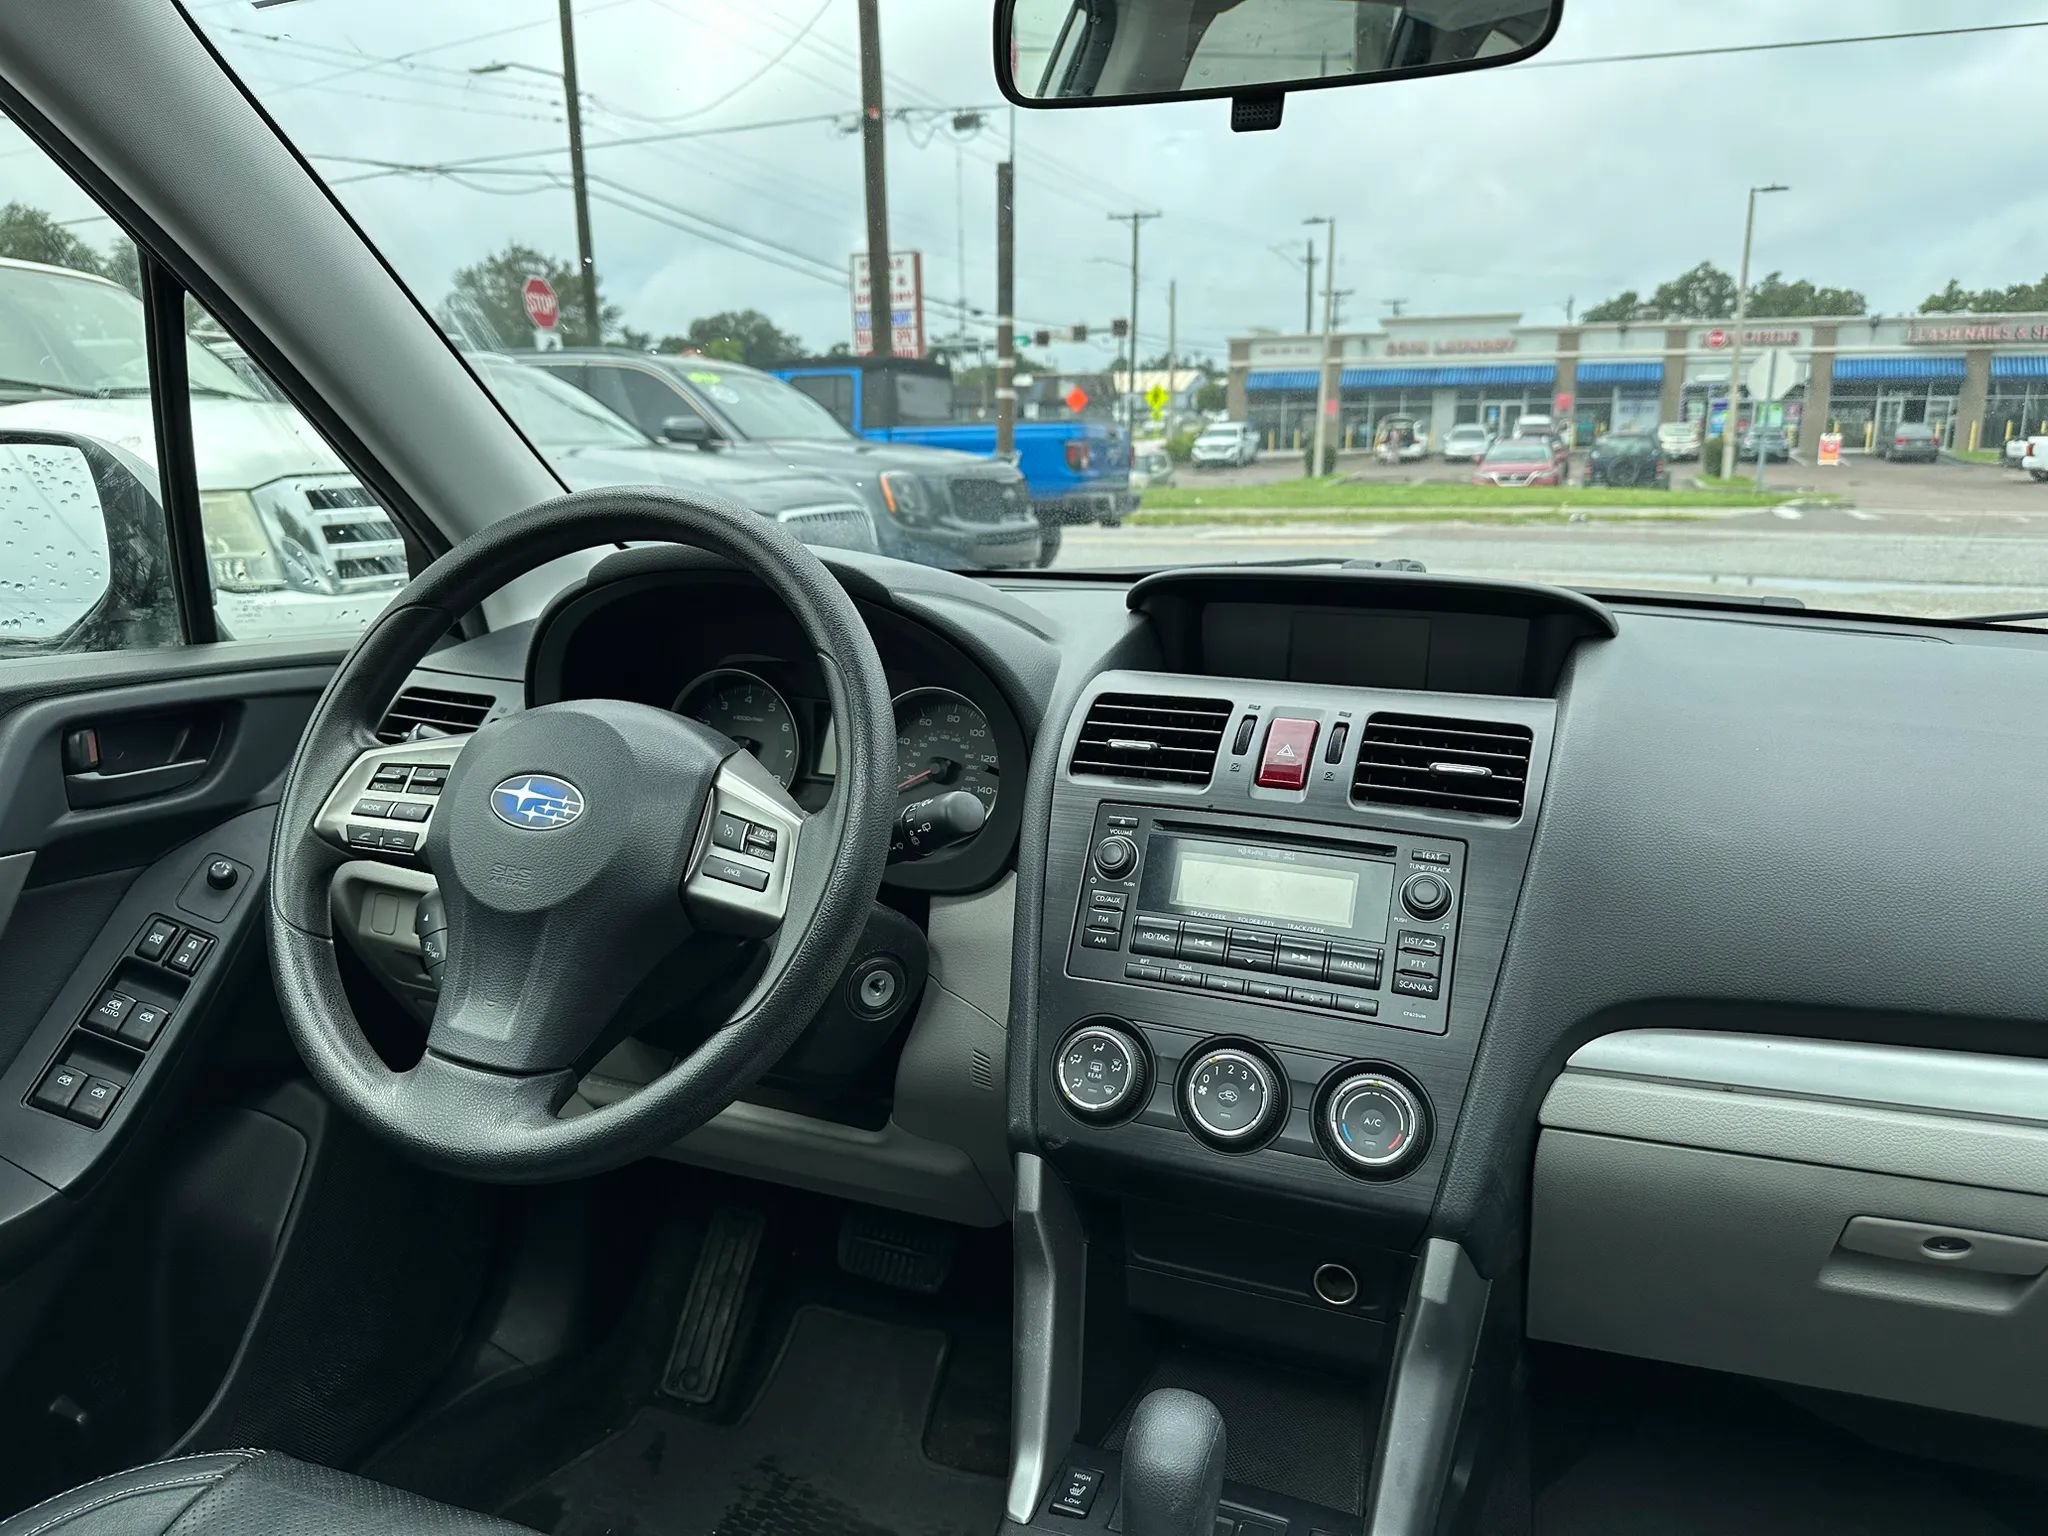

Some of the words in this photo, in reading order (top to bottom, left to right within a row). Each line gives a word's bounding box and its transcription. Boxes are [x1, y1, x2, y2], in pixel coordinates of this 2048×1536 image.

[527, 291, 556, 315] STOP
[744, 696, 752, 704] 4
[721, 701, 729, 711] 3
[768, 703, 776, 712] 5
[920, 719, 932, 727] 60
[946, 714, 960, 723] 80
[781, 722, 790, 732] 6
[969, 729, 985, 738] 100
[784, 750, 793, 758] 7
[981, 754, 997, 763] 120
[977, 786, 993, 795] 140
[1109, 828, 1133, 836] VOLUME
[1422, 851, 1440, 860] TEXT
[1409, 862, 1451, 873] TUNE/TRACK
[1095, 895, 1121, 904] CD/AUX
[1098, 915, 1109, 923] FM
[1287, 923, 1326, 934] TRACK/SEEK
[1094, 936, 1107, 944] AM
[1142, 931, 1171, 942] HD/TAG
[1341, 959, 1366, 970] MENU
[1411, 960, 1427, 968] PTY
[1309, 994, 1315, 1002] 5
[1354, 1001, 1360, 1009] 6
[100, 1006, 119, 1017] AUTO
[1228, 1065, 1235, 1075] 2
[1203, 1074, 1210, 1083] 0
[1241, 1070, 1248, 1080] 3
[1249, 1082, 1255, 1092] 4
[1364, 1117, 1381, 1128] A/C
[1074, 1472, 1092, 1482] HIGH
[1064, 1496, 1081, 1505] LOW
